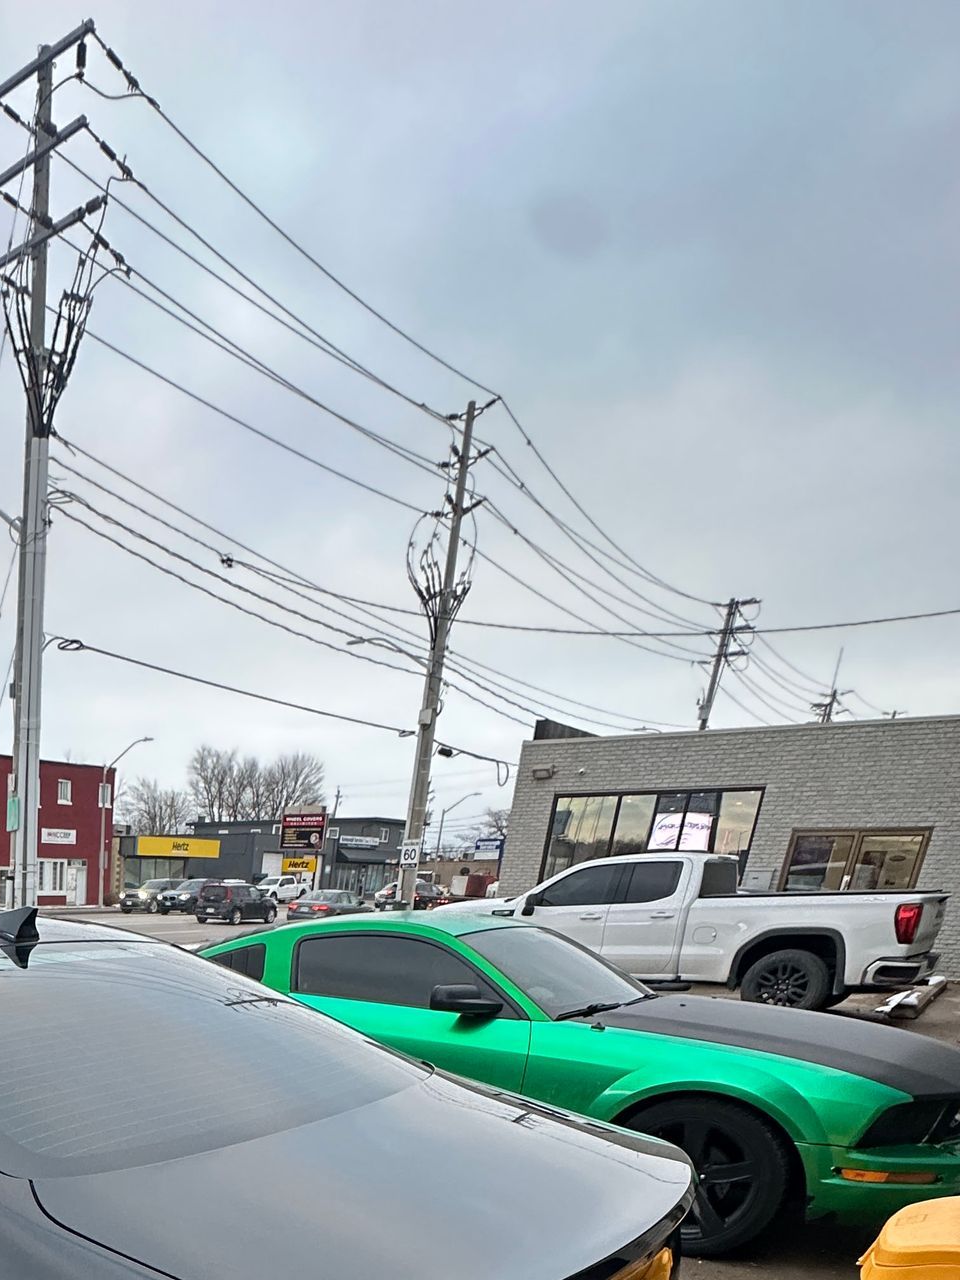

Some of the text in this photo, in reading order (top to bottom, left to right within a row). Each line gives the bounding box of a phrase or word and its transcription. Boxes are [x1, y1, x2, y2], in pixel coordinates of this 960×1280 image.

[172, 841, 189, 851] Hertz
[404, 848, 417, 861] 60
[288, 860, 309, 869] Hertz
